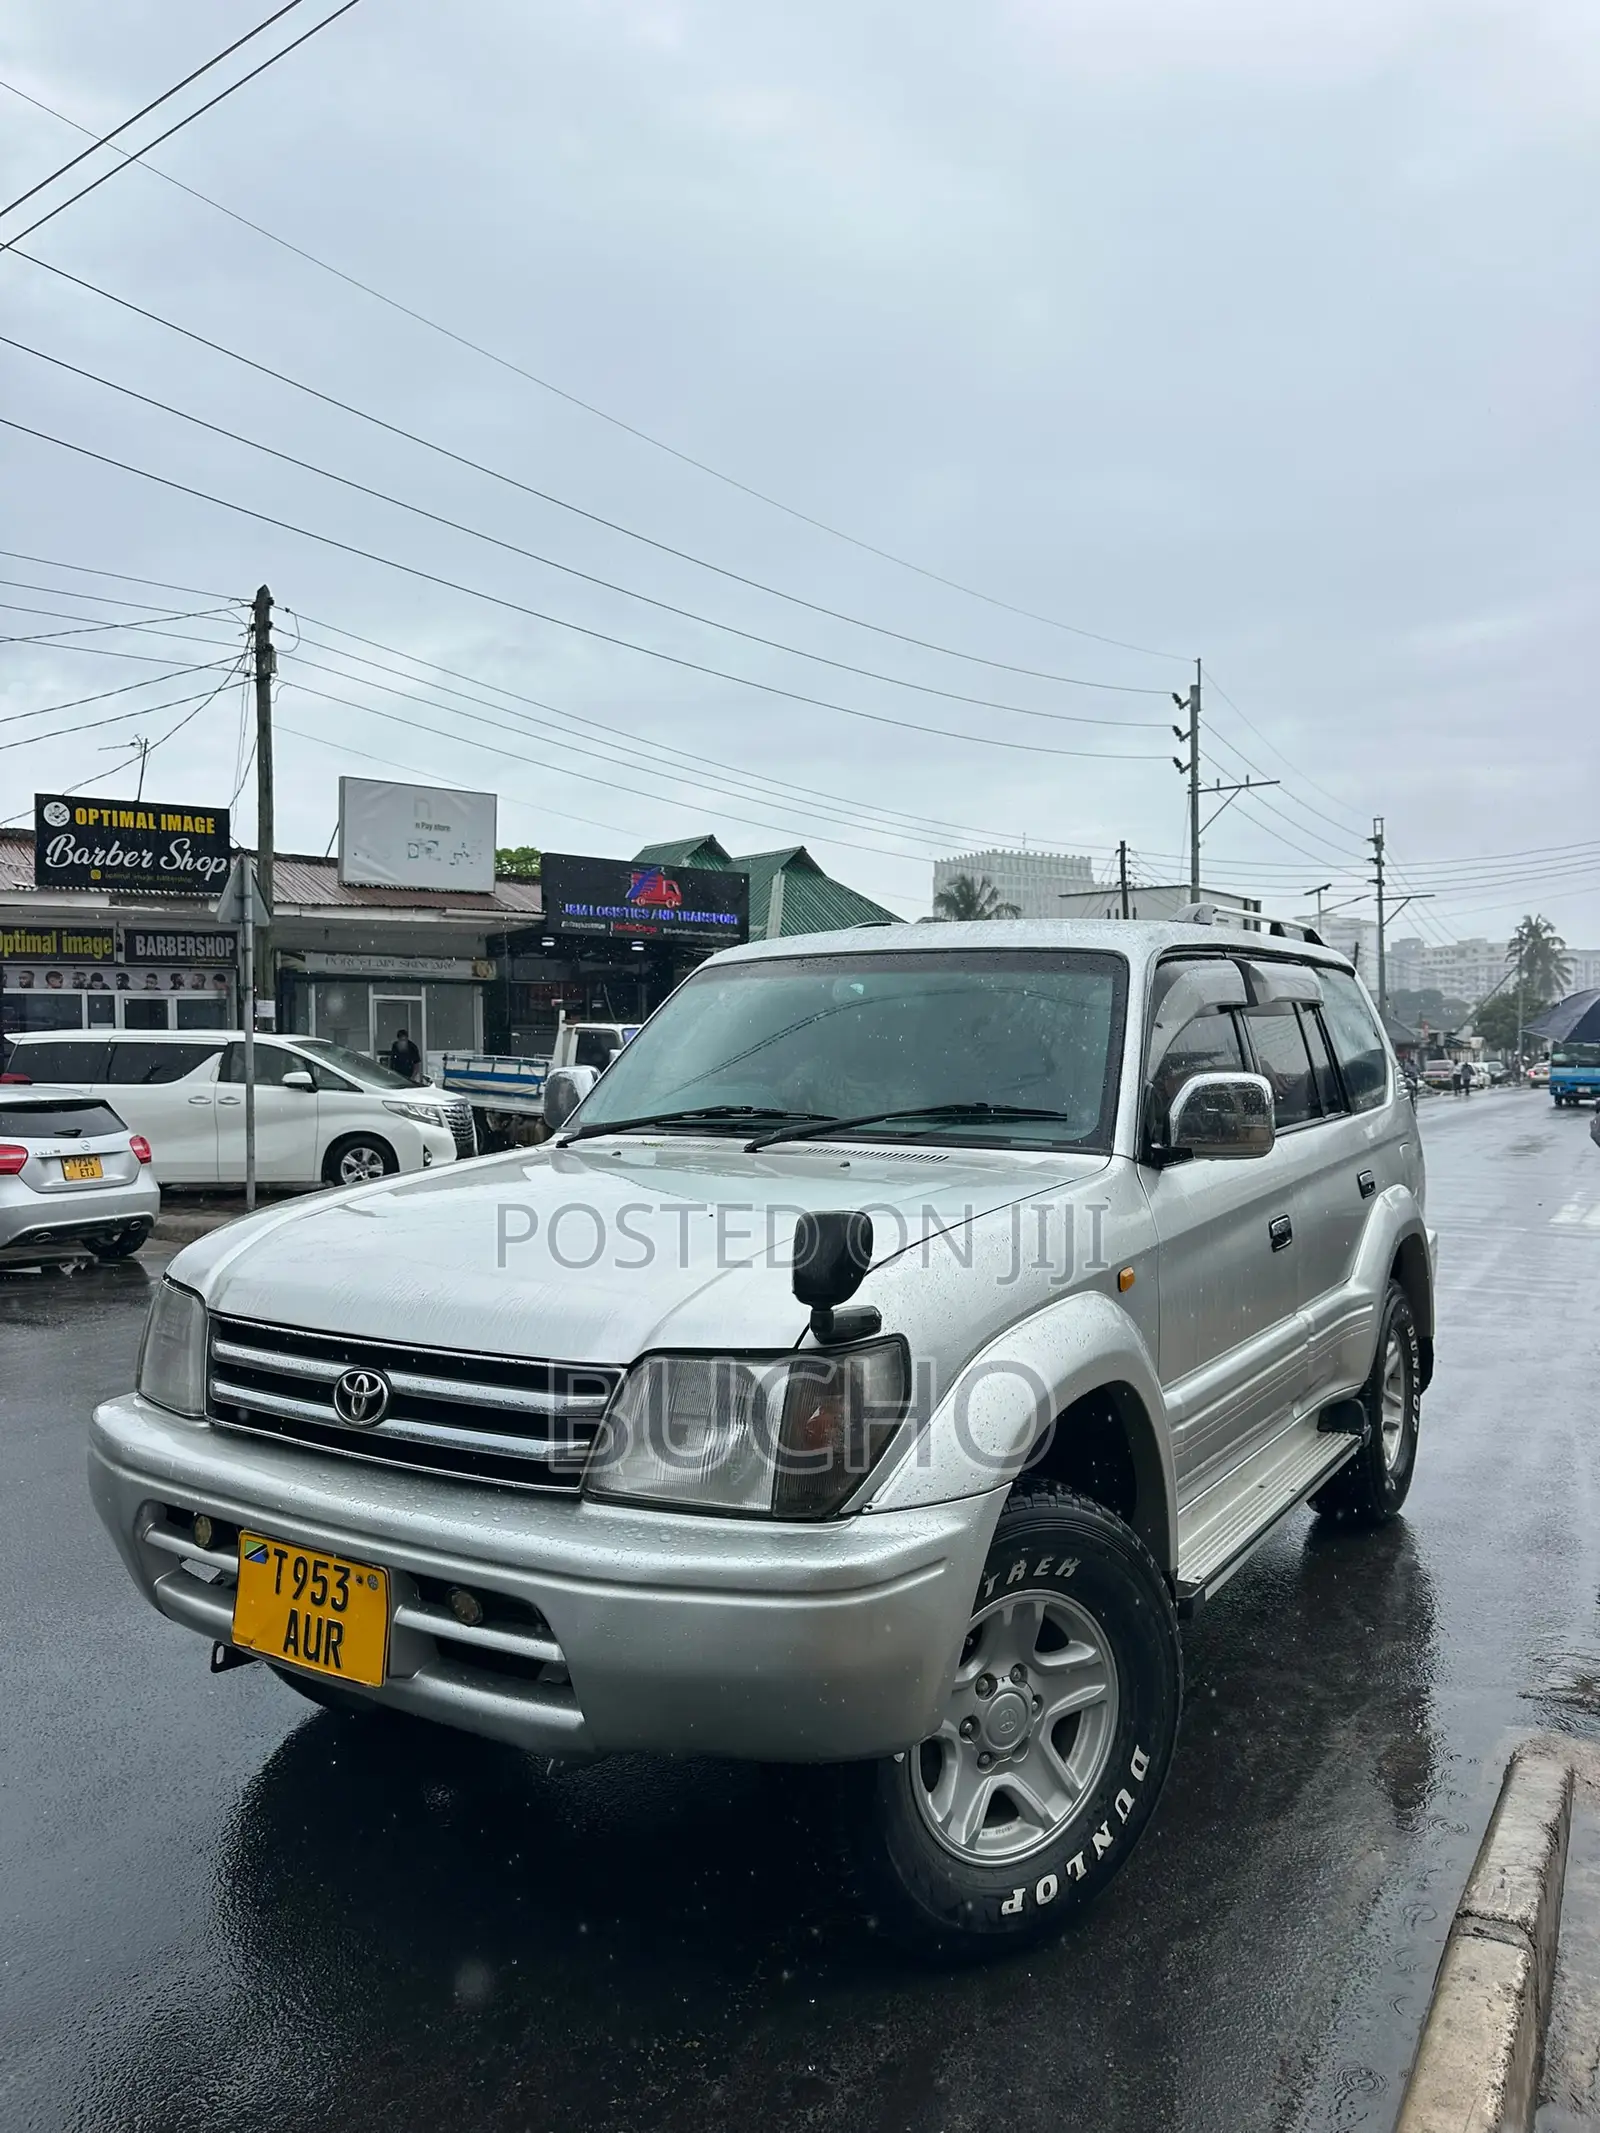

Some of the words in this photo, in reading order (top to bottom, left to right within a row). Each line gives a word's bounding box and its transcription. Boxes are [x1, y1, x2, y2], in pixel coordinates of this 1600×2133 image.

[74, 807, 156, 830] OPTIMAL
[161, 813, 216, 834] IMAGE
[421, 821, 433, 831] Pay
[45, 833, 154, 868] Barber
[159, 837, 228, 881] Shop
[589, 904, 650, 919] LOGISTICS
[651, 908, 675, 921] AND
[62, 930, 113, 959] image
[135, 935, 235, 957] BARBERSHOP
[80, 1168, 96, 1177] ETJ
[273, 1547, 351, 1612] T953
[282, 1608, 344, 1669] AUR
[1001, 1744, 1151, 1916] DUNLOP
